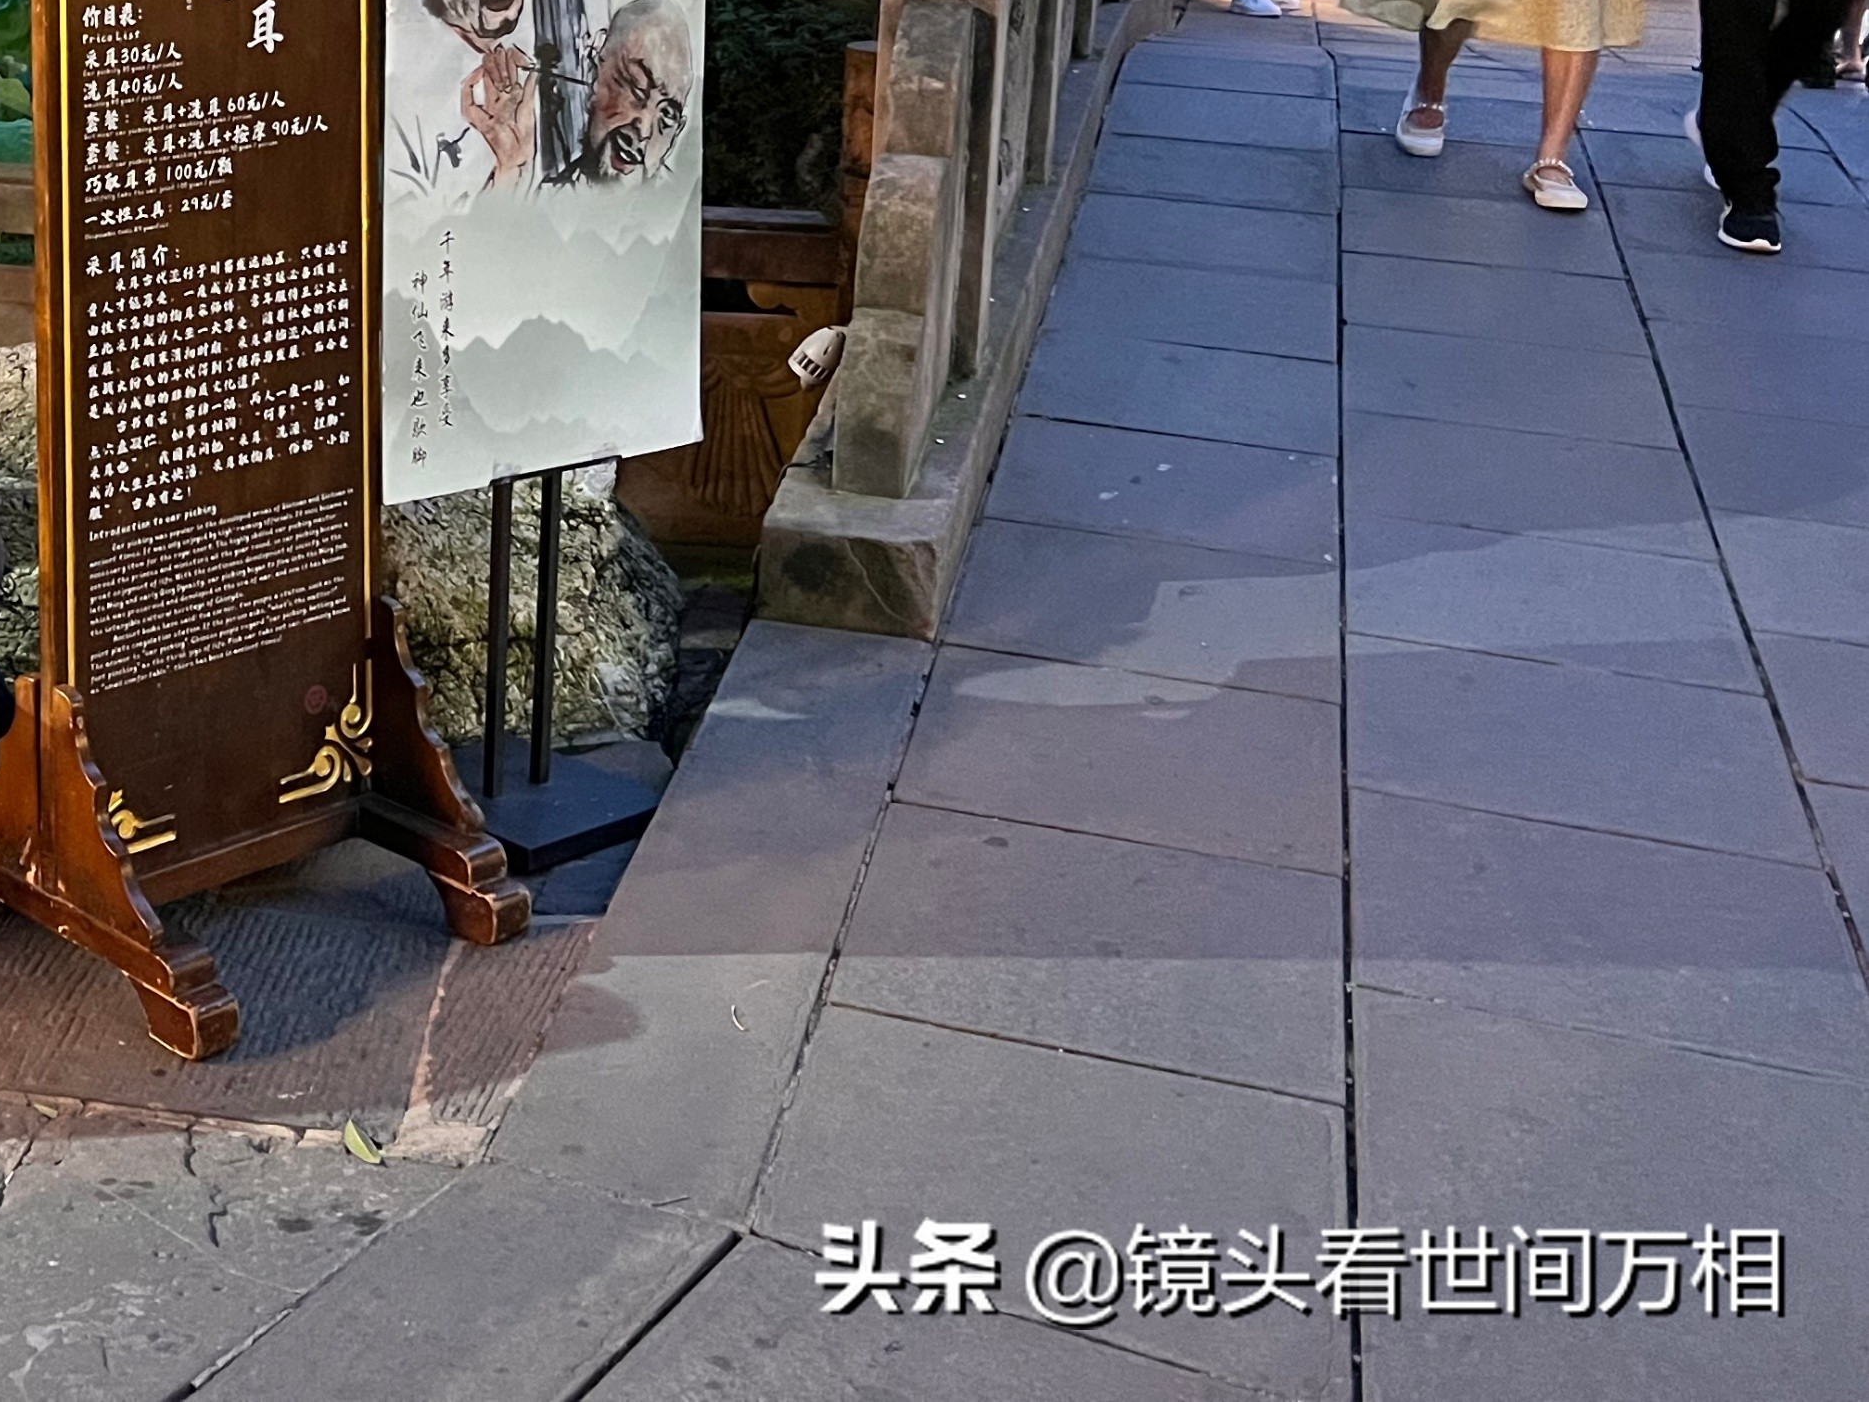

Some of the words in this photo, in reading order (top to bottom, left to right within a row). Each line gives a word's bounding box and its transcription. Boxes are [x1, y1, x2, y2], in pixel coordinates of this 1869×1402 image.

[82, 34, 115, 45] Price
[115, 29, 141, 43] List
[84, 42, 182, 69] 采耳30元/人
[83, 72, 183, 102] 洗耳40元/人
[227, 90, 285, 113] 60元/人
[271, 114, 329, 136] 90元/人
[180, 189, 234, 212] 29元/套
[89, 521, 150, 541] Introduction
[153, 518, 163, 526] to
[164, 514, 180, 523] ear
[184, 505, 216, 521] picking
